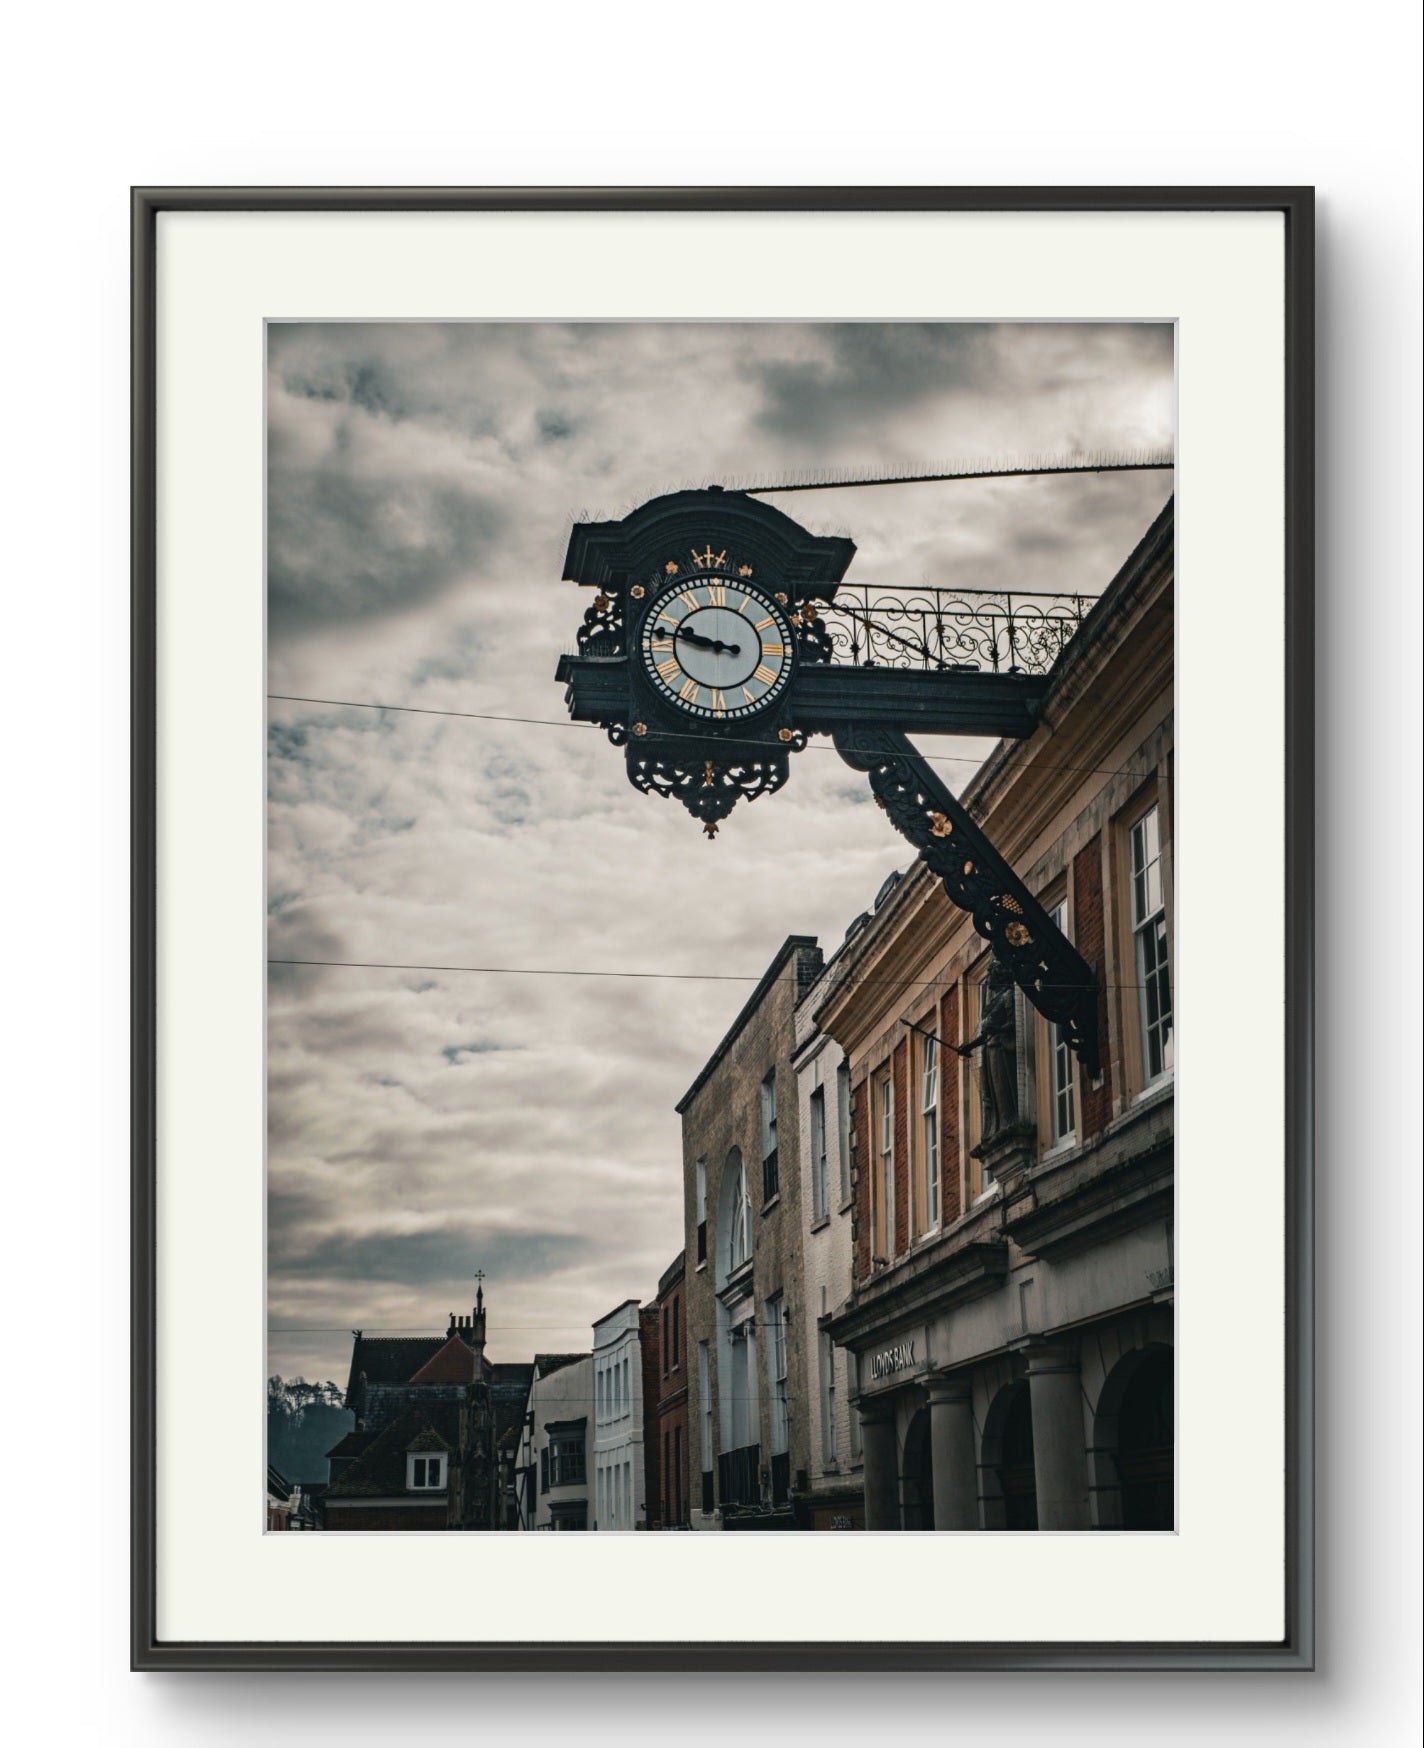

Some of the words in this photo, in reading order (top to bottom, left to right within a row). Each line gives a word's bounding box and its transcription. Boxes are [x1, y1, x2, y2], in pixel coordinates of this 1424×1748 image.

[678, 590, 700, 613] XI
[708, 586, 727, 607] XII
[738, 595, 751, 613] I
[658, 612, 680, 629] X
[755, 616, 777, 633] II
[651, 640, 673, 652] IX
[762, 643, 783, 656] III
[655, 657, 683, 686] VIII
[752, 663, 779, 687] IIII
[678, 677, 701, 704] VII
[712, 688, 727, 710] VI
[741, 685, 757, 704] V
[870, 1349, 894, 1379] LLOYDS
[894, 1340, 915, 1371] BANK
